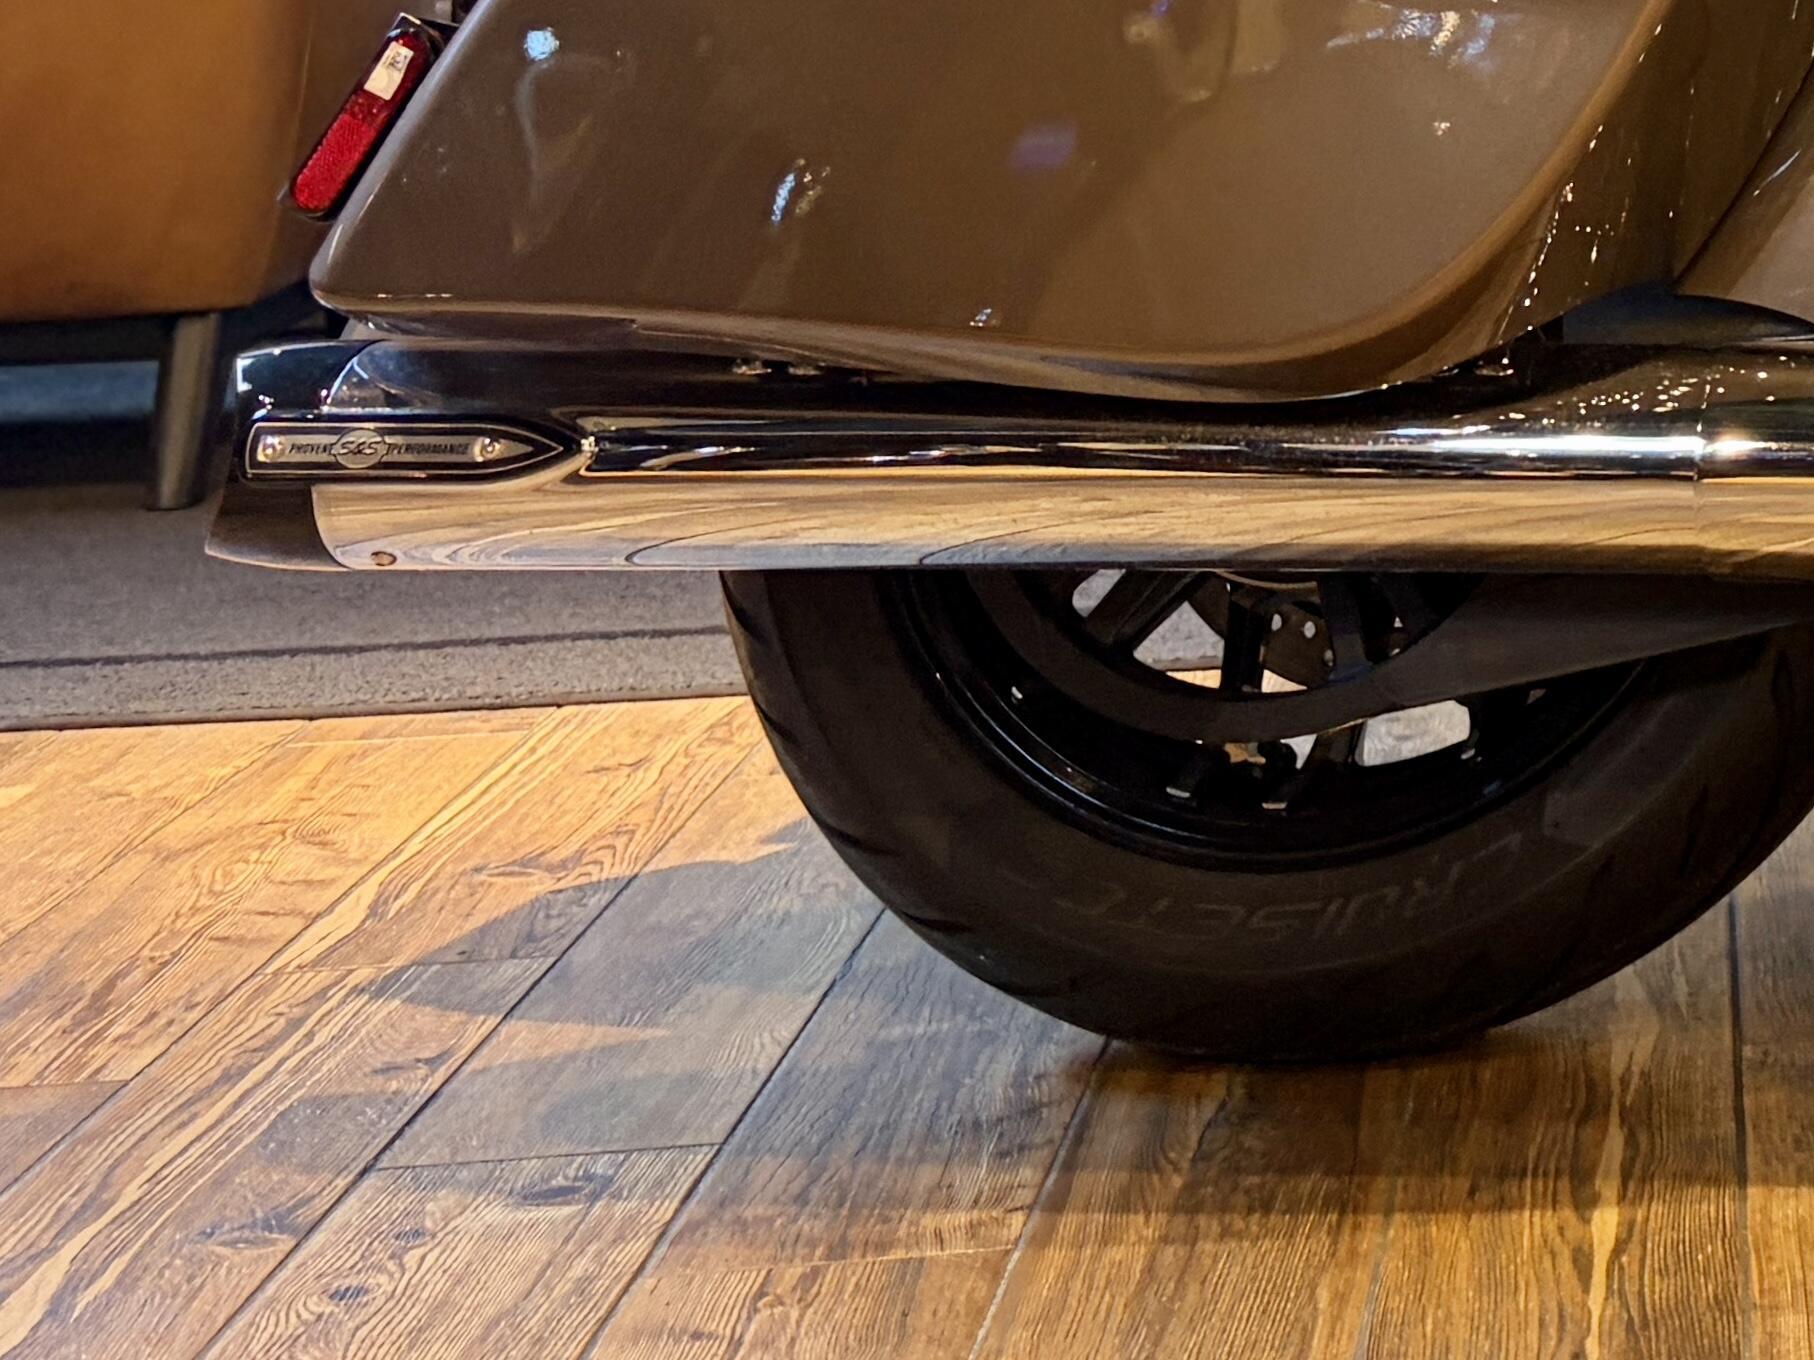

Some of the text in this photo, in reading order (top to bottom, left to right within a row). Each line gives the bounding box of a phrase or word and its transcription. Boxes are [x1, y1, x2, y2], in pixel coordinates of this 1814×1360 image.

[288, 440, 471, 456] PROVEN S&S PERFORMANCE
